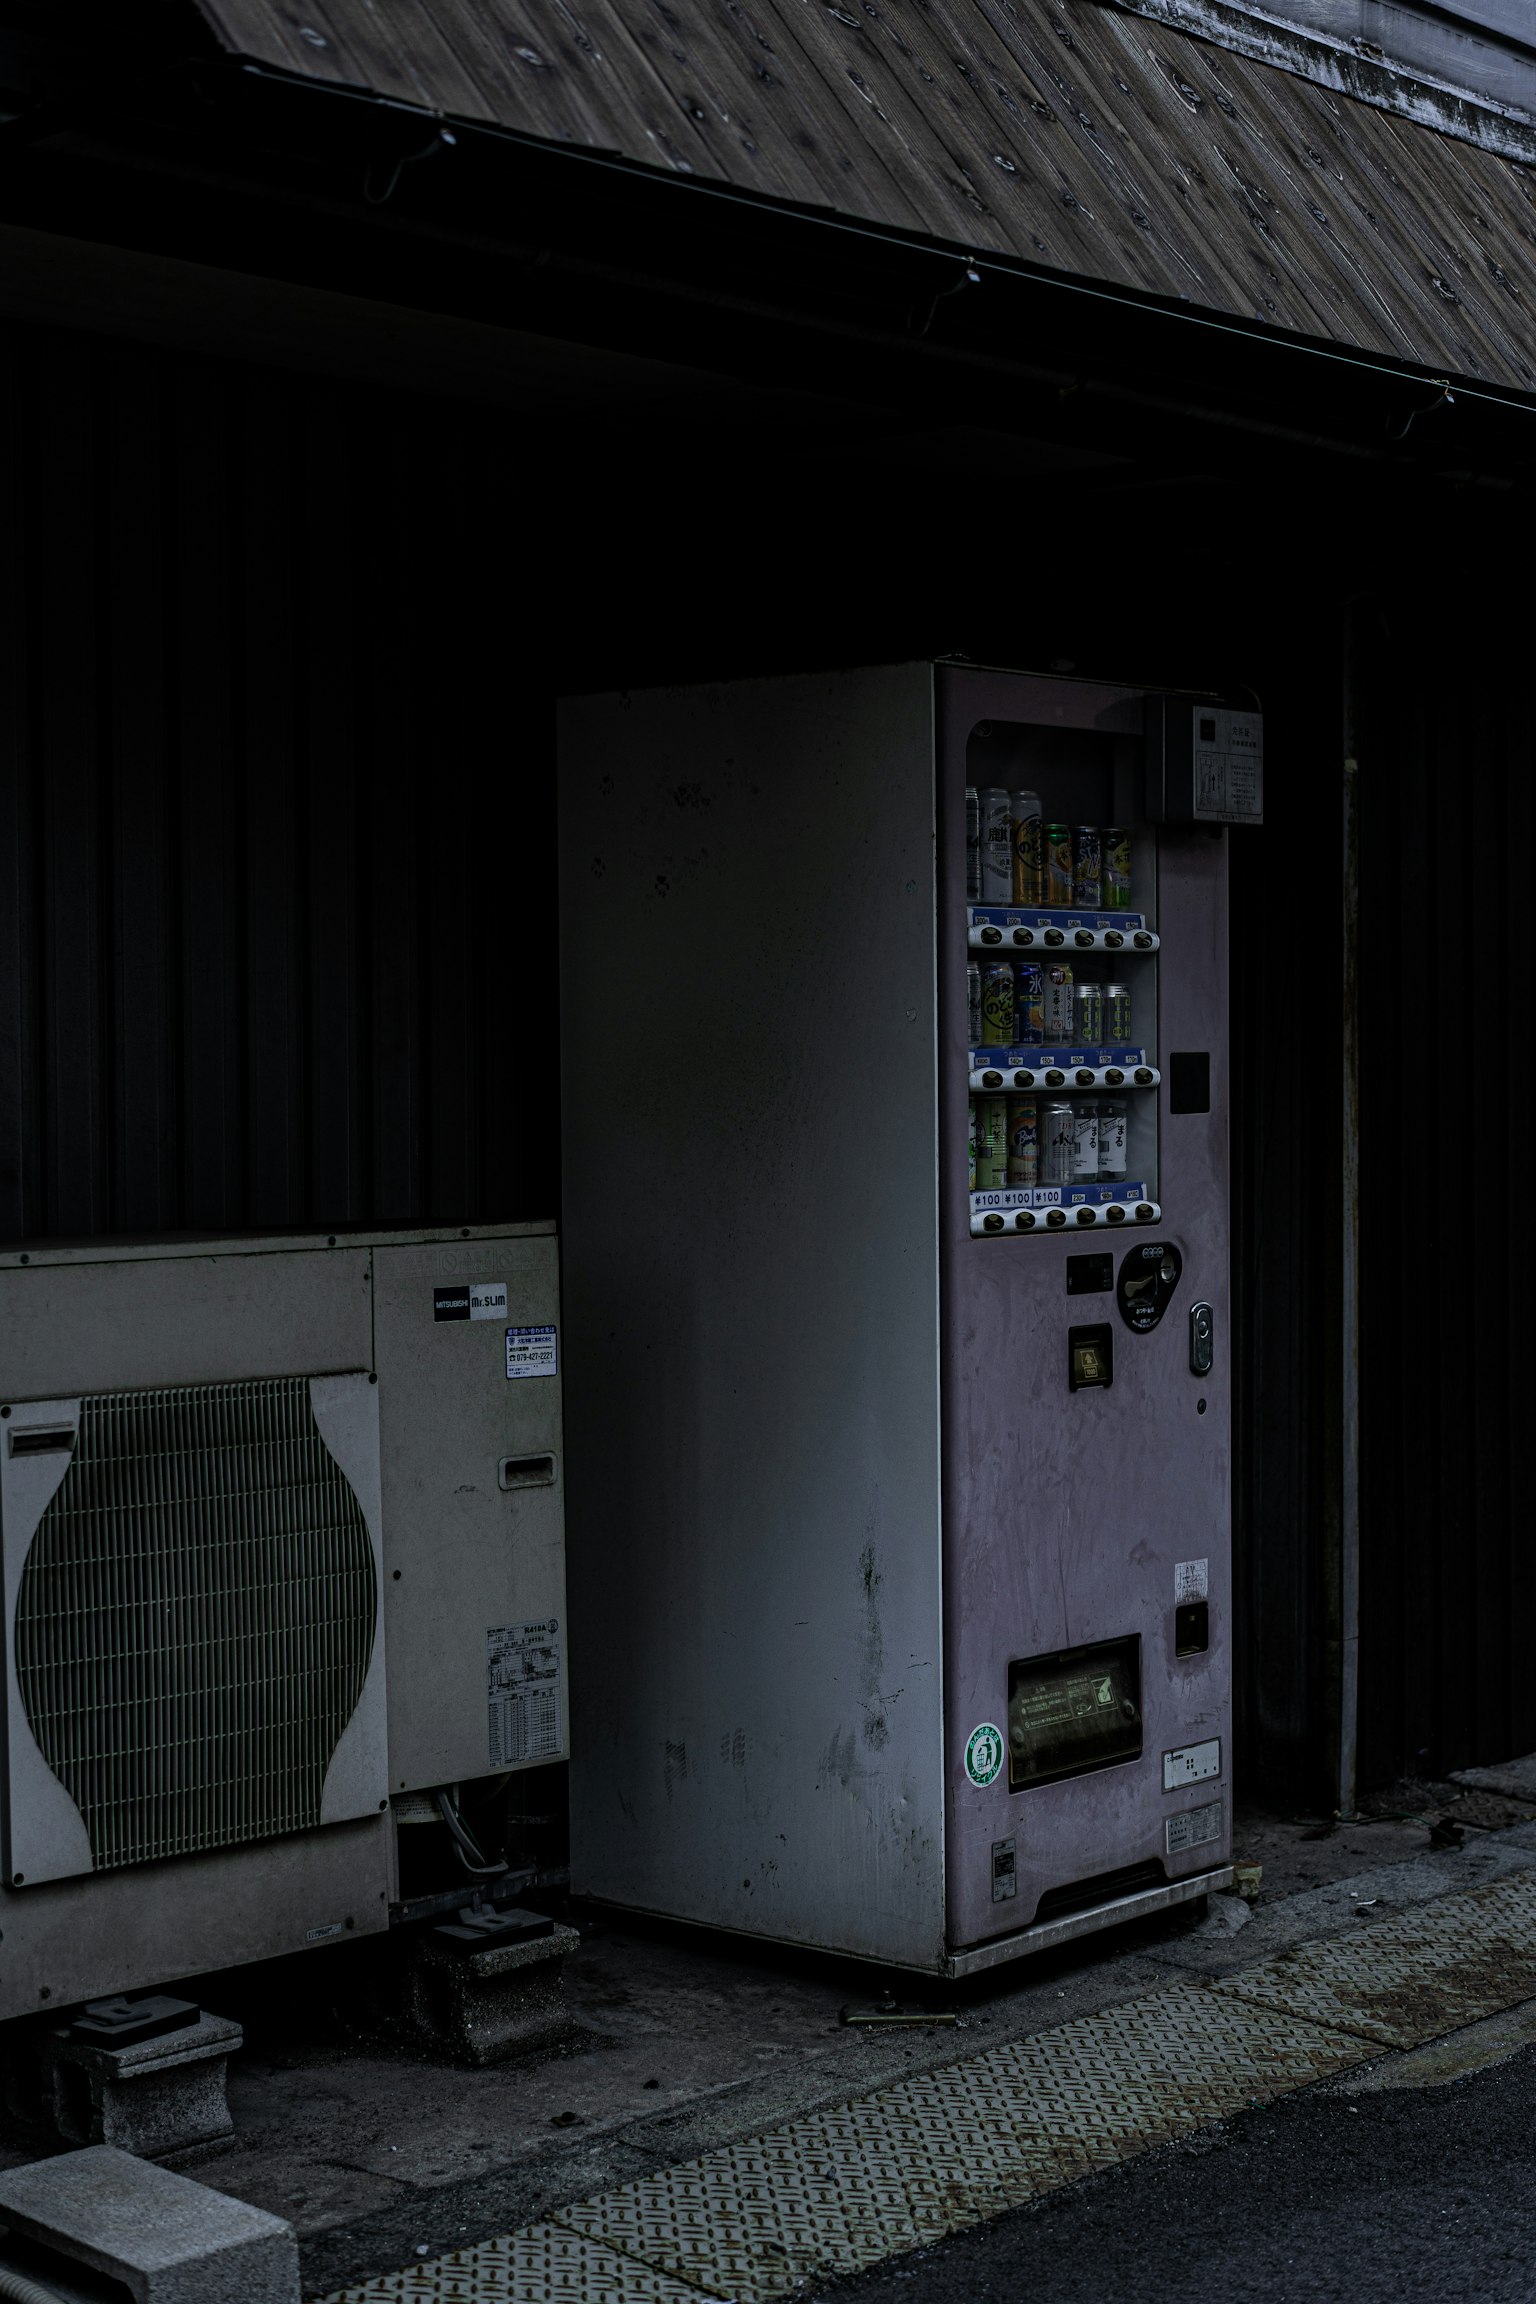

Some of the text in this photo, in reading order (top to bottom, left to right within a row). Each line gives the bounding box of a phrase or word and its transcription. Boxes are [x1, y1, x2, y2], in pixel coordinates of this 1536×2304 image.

[974, 1194, 1000, 1206] ¥100
[1005, 1193, 1030, 1204] ¥100
[1036, 1191, 1059, 1203] ¥100
[435, 1299, 469, 1309] MITSUBISHI
[524, 1625, 547, 1634] R410A
